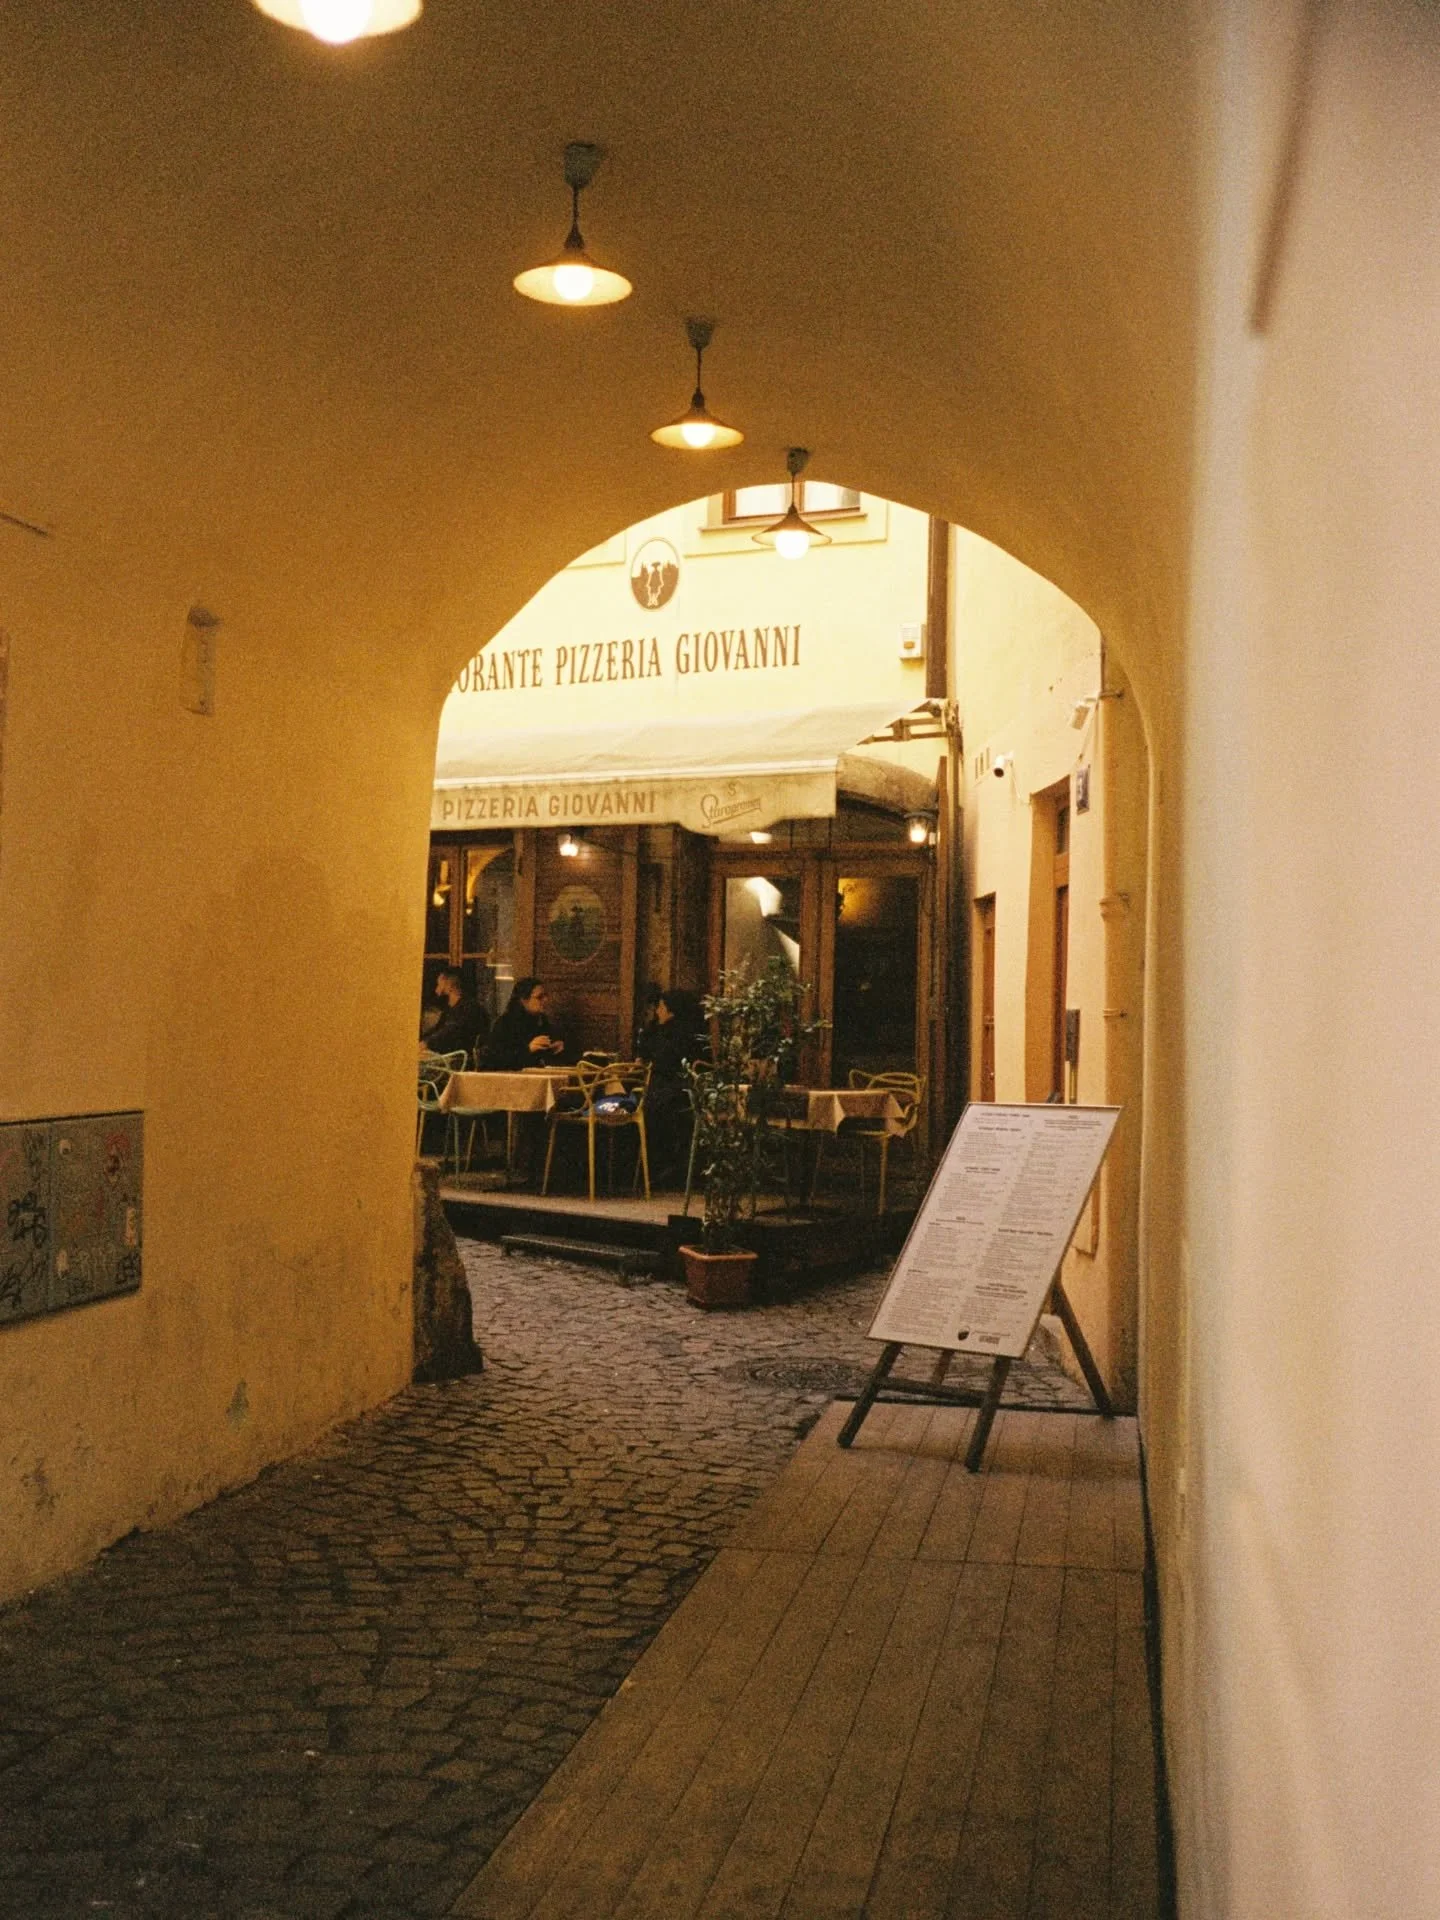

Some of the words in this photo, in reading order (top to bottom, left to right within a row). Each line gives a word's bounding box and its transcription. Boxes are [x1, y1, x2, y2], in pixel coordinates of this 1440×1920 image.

[556, 637, 662, 686] PIZZERIA
[676, 624, 801, 674] GIOVANNI
[442, 796, 539, 821] PIZZERIA
[549, 791, 656, 817] GIOVANNI
